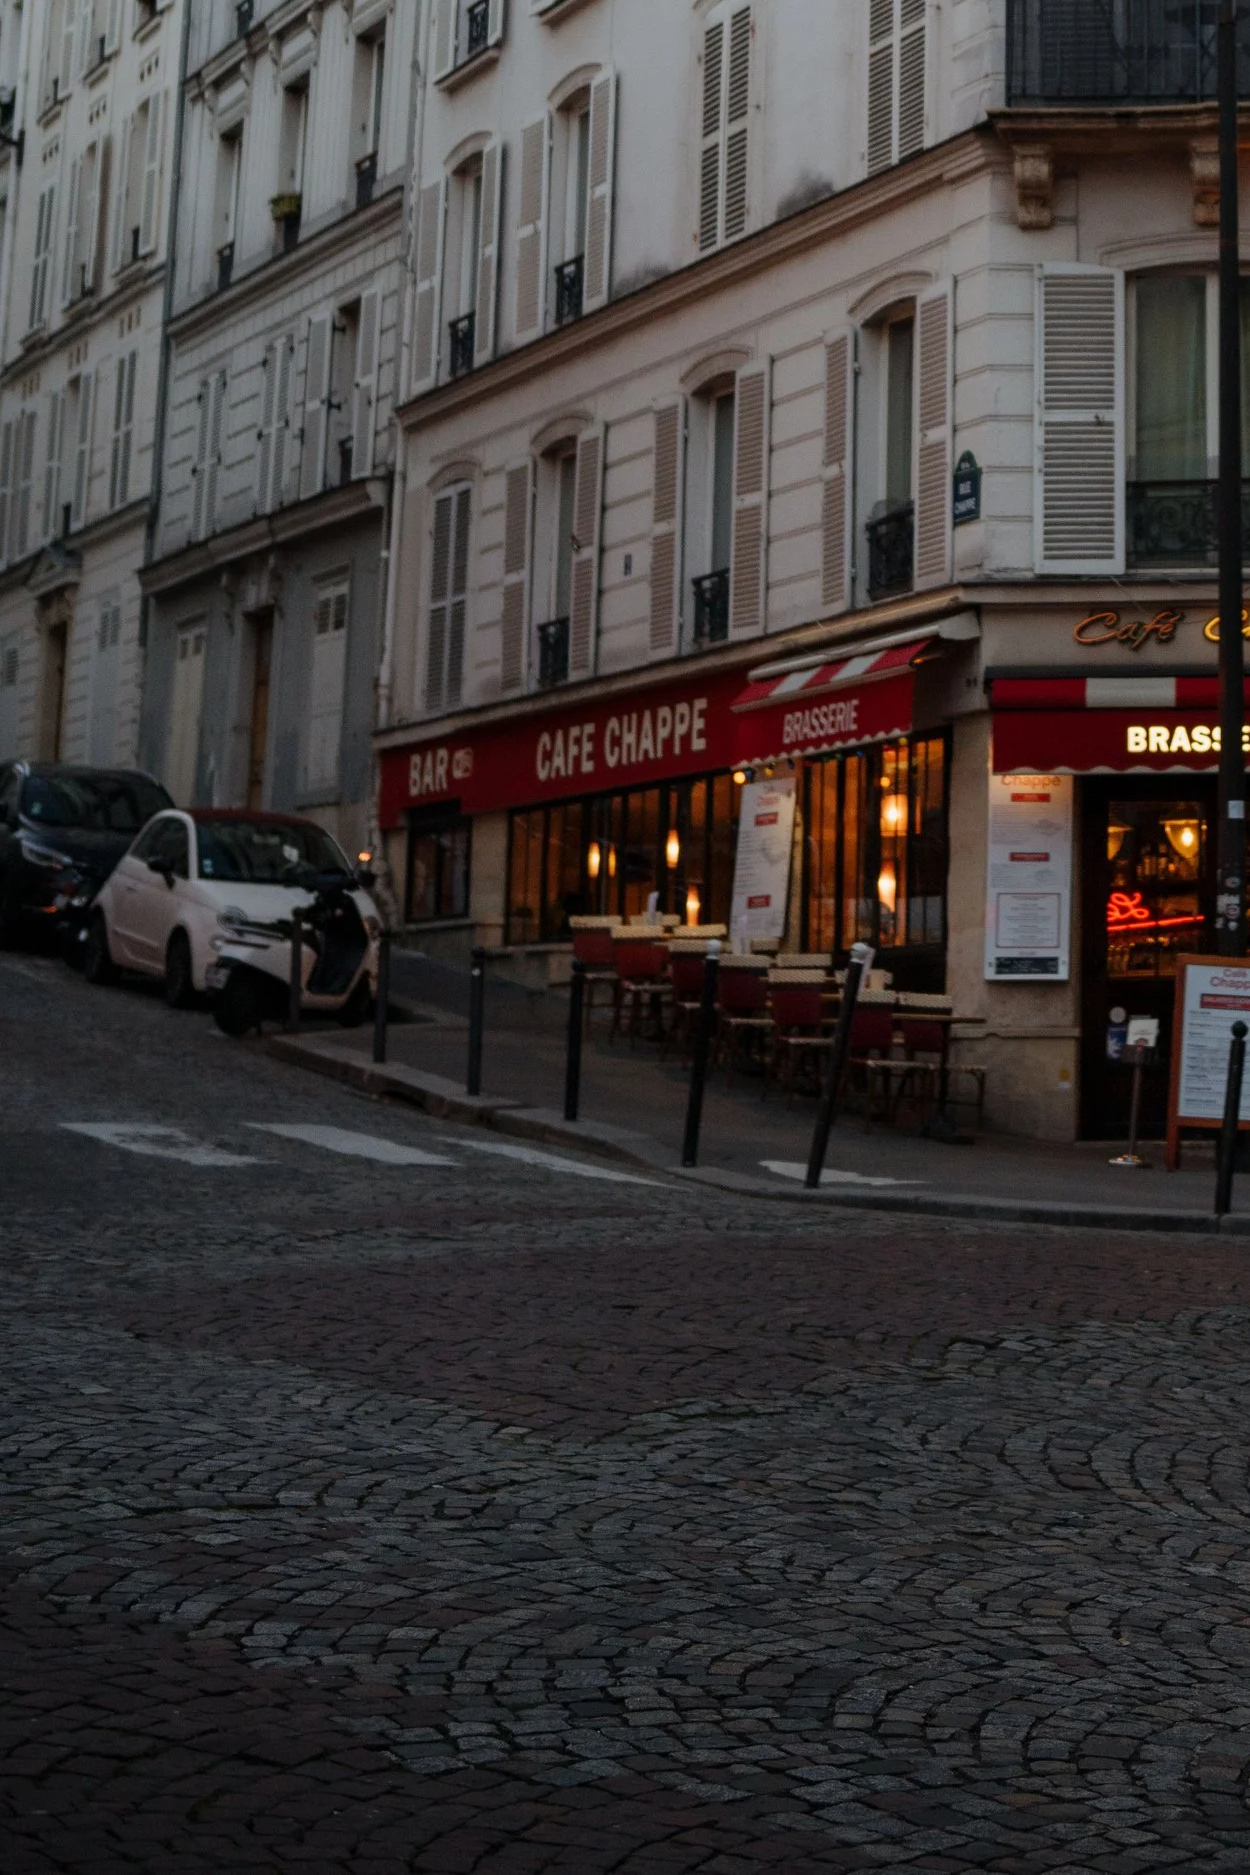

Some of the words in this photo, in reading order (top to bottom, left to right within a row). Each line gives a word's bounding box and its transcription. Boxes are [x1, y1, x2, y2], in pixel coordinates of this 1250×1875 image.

[1073, 610, 1184, 652] Café
[536, 723, 596, 782] CAFE
[604, 698, 708, 768] CHAPPE
[782, 699, 860, 745] BRASSERIE
[409, 748, 448, 797] BAR
